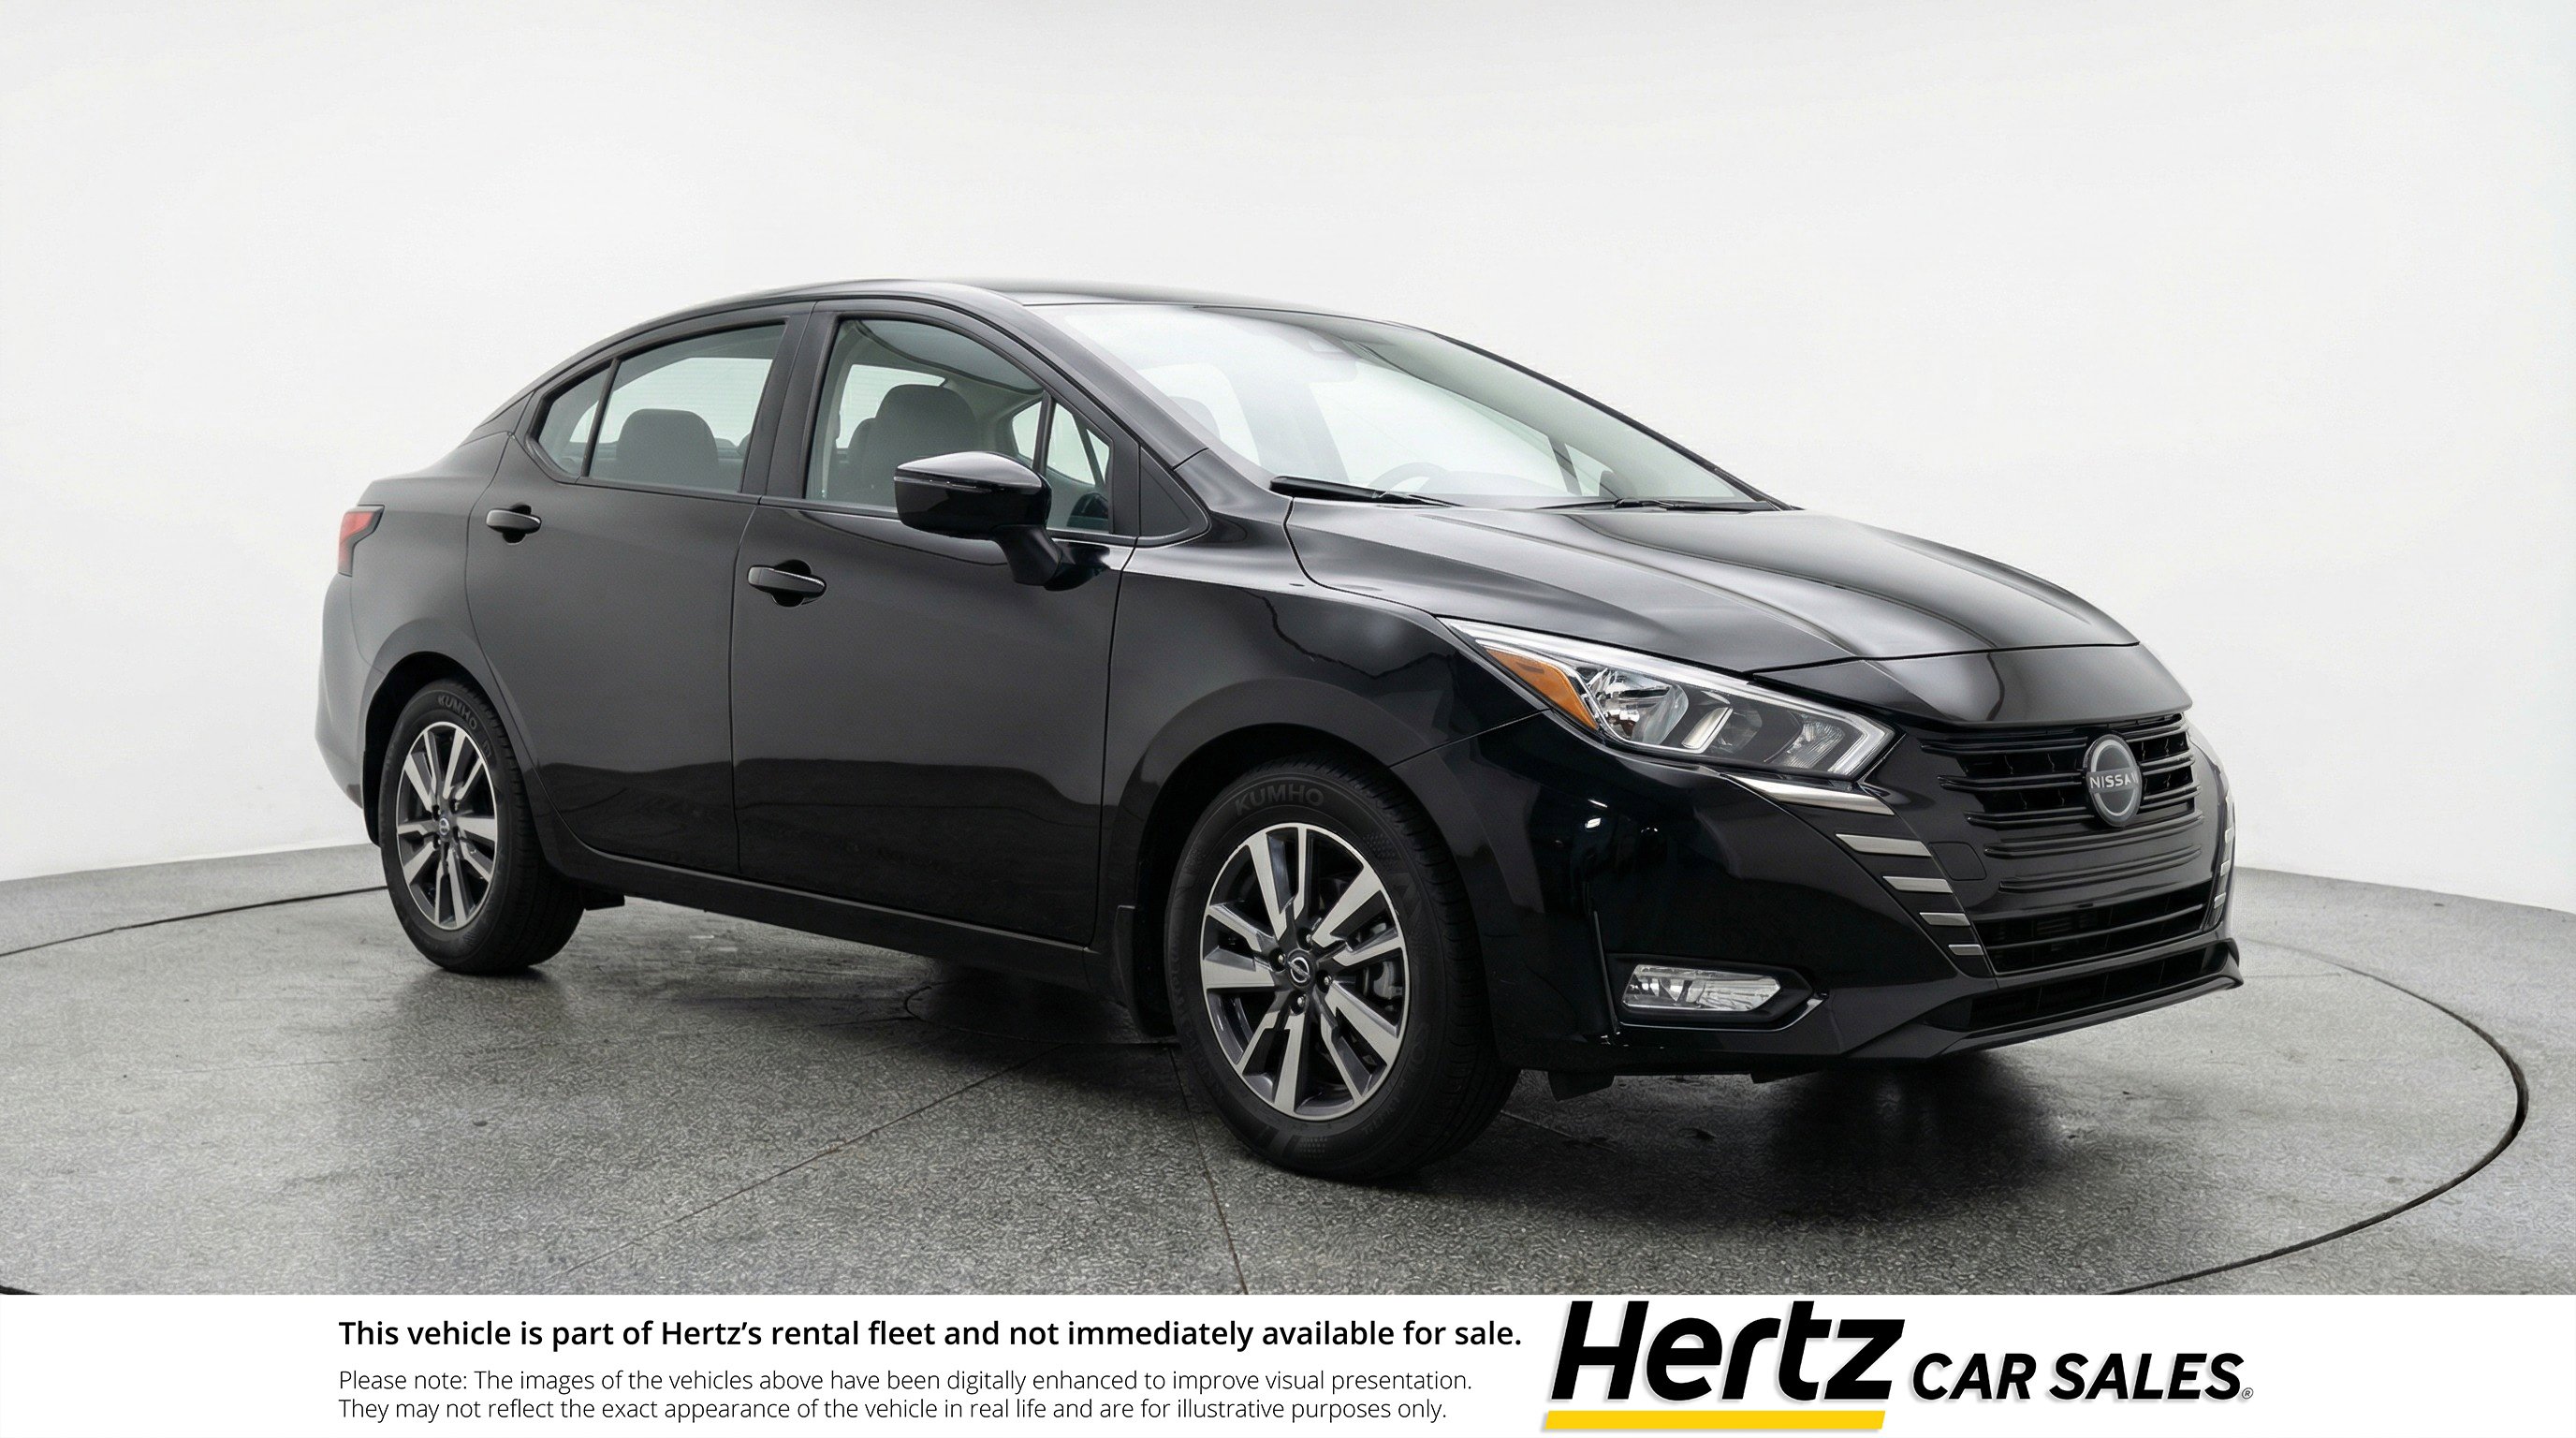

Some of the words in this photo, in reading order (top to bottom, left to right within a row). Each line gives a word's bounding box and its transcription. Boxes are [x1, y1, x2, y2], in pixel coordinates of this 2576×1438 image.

[437, 695, 477, 730] KUMHO
[2089, 771, 2139, 789] NISSAN
[1235, 783, 1325, 816] KUMHO
